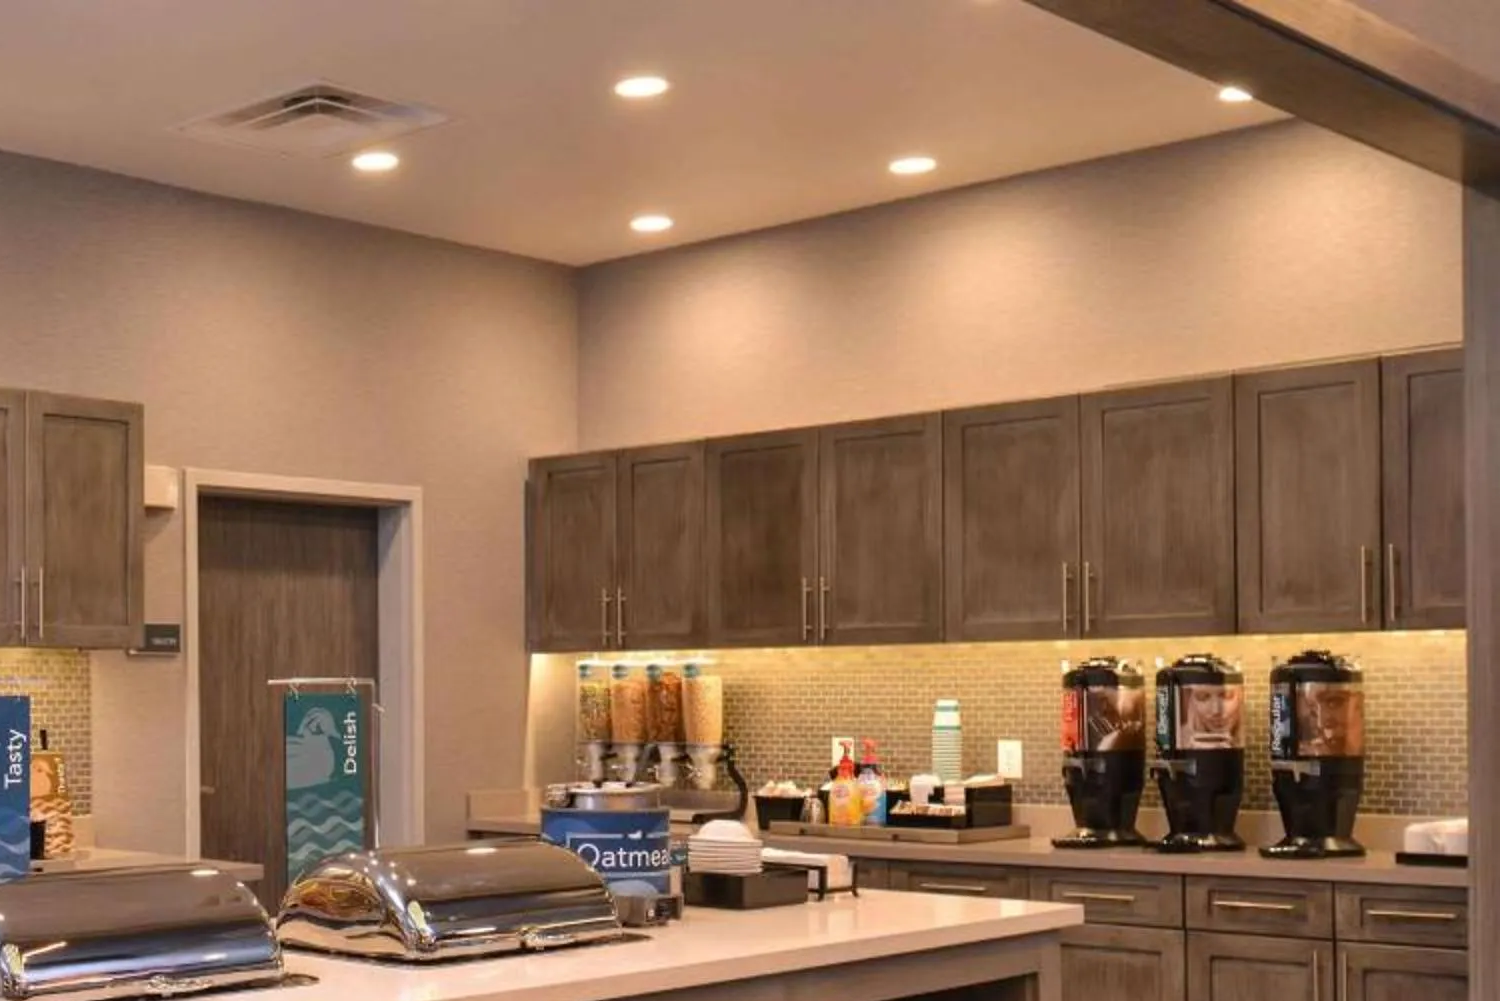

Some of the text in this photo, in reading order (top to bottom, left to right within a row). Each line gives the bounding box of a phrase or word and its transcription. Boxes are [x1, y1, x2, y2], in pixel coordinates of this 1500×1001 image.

[343, 711, 357, 774] Delish
[1271, 694, 1282, 751] Regular
[3, 729, 27, 790] Tasty
[577, 843, 670, 867] Oatmea
